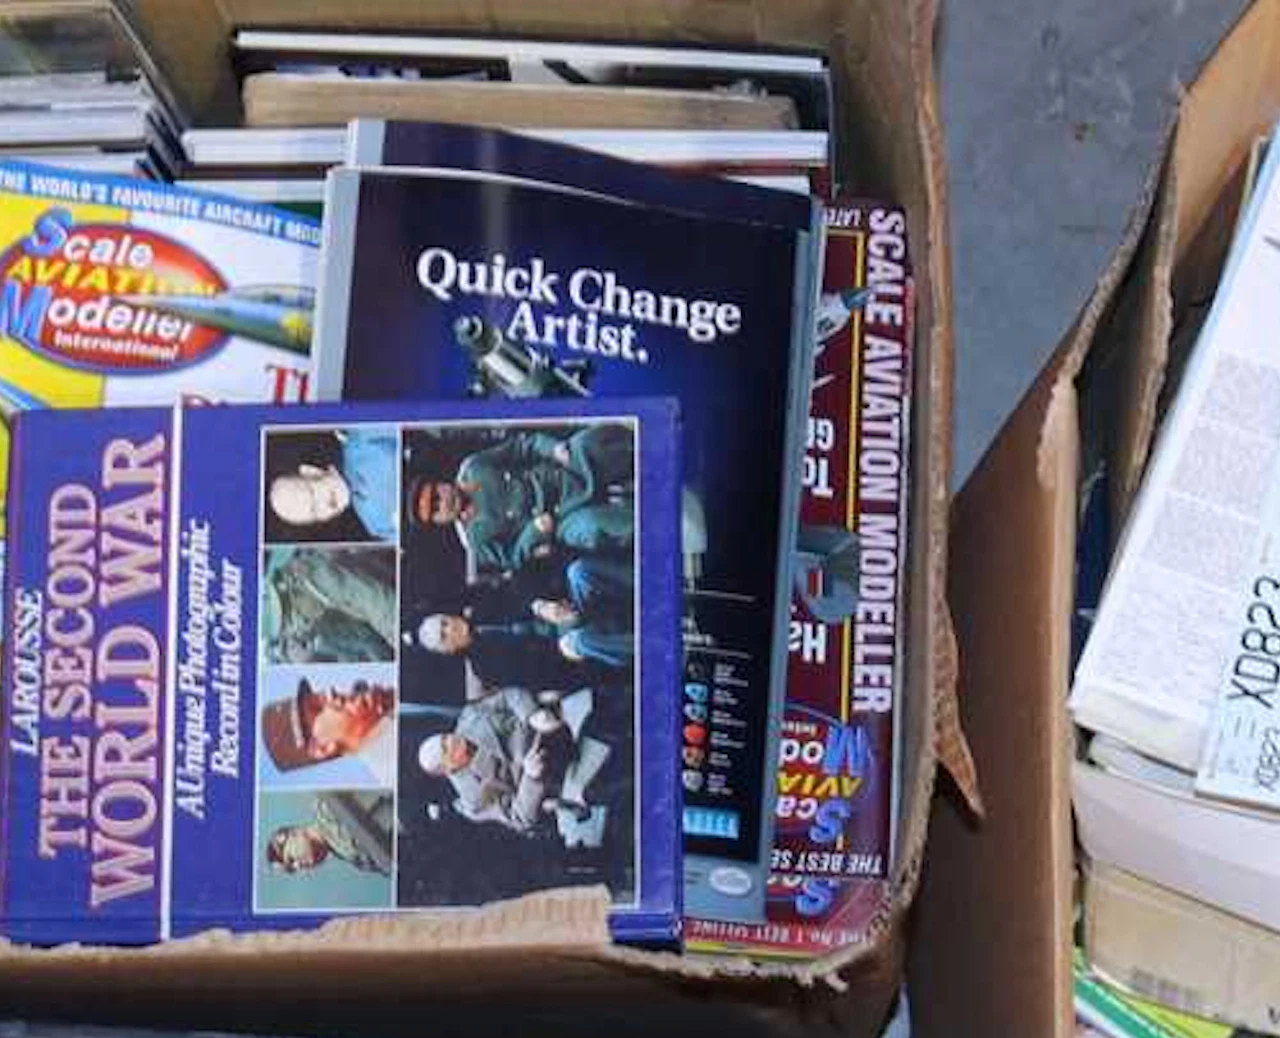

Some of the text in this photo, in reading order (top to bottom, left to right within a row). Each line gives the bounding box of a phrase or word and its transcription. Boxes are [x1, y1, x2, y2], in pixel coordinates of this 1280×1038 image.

[23, 207, 155, 269] Scale
[31, 175, 107, 201] WORLD'S
[112, 184, 200, 218] FAVOURITE
[204, 199, 283, 236] AIRCRAFT
[416, 248, 742, 342] Quick Change
[507, 300, 650, 364] Artist.
[54, 330, 182, 361] International
[853, 206, 906, 714] SCALE AVIATION MODELLER
[178, 518, 213, 694] Photographic
[213, 559, 245, 662] Colour
[10, 588, 43, 757] LAROUSSE
[40, 483, 98, 861] THE SECOND
[91, 433, 166, 908] WORLD WAR
[176, 694, 211, 790] Unique
[210, 698, 239, 779] Record
[795, 849, 843, 875] BEST
[846, 852, 882, 876] THE
